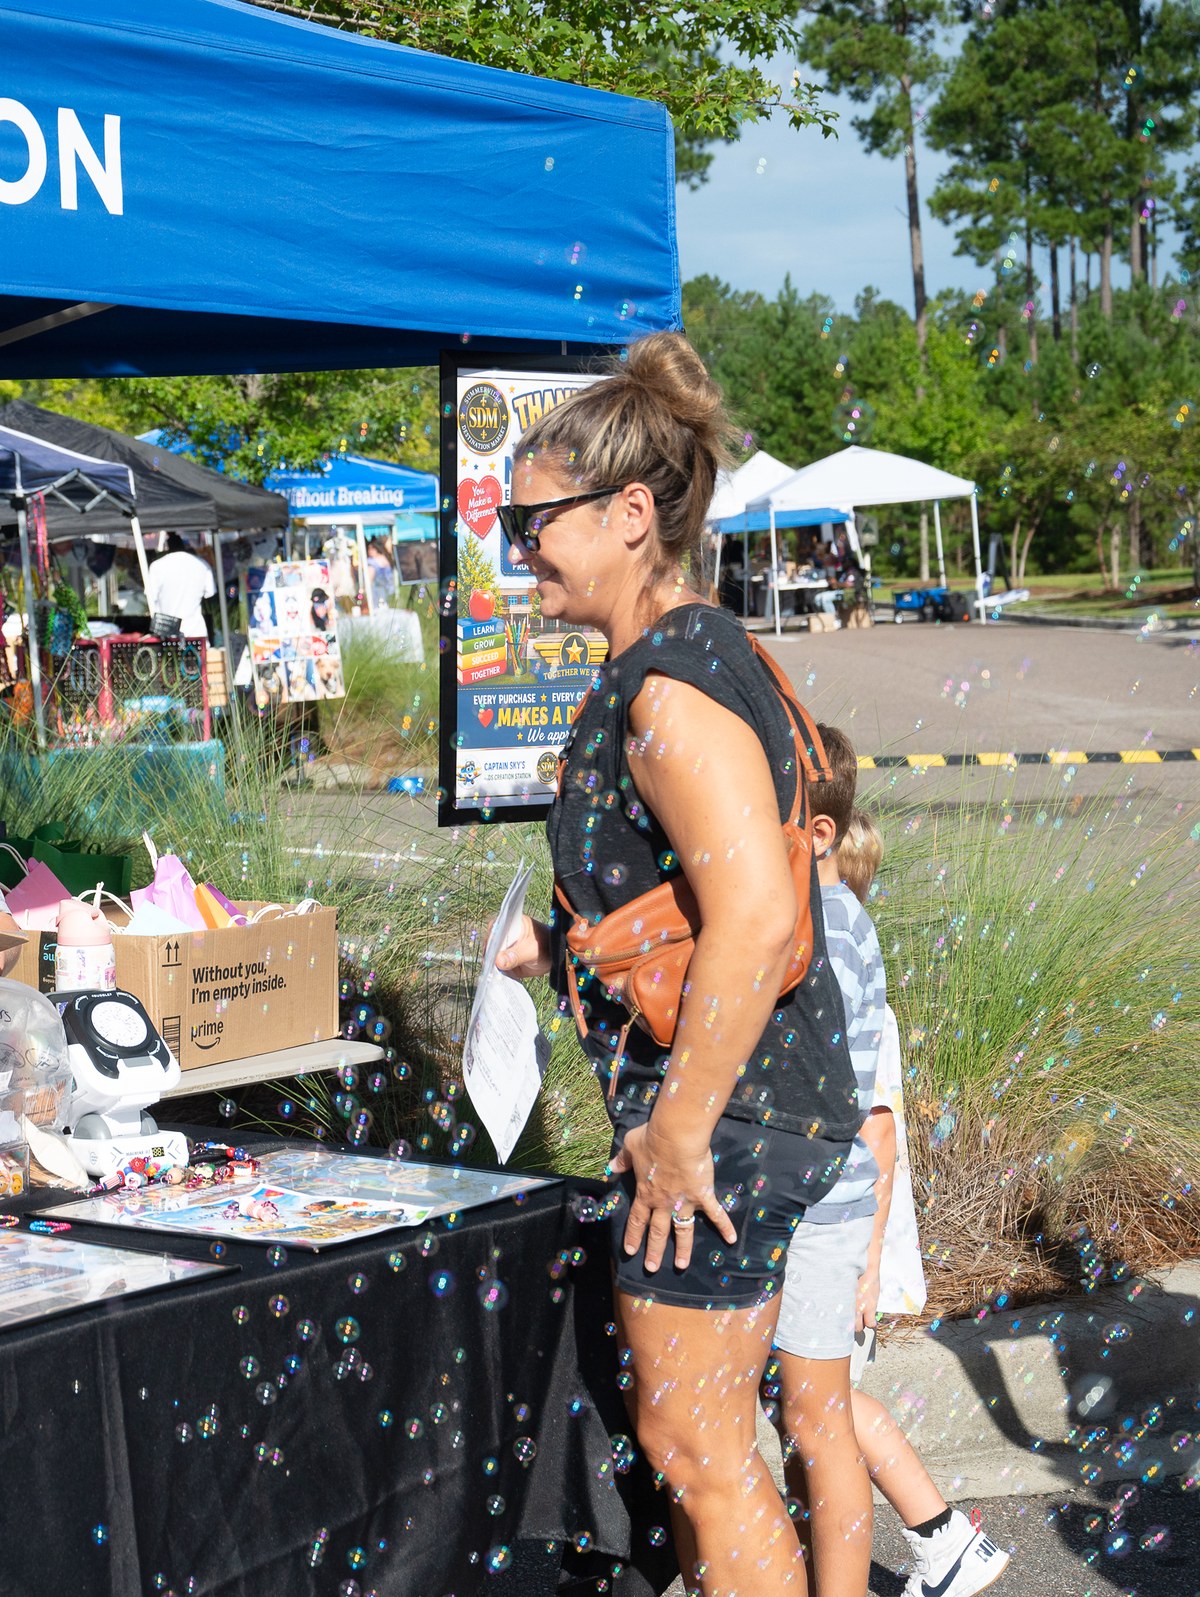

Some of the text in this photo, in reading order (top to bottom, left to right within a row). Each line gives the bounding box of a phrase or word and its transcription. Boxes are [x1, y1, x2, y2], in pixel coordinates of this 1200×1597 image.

[513, 388, 579, 430] THA
[468, 406, 498, 429] SDM
[461, 425, 506, 450] DESTINATION MARKET
[337, 485, 404, 507] Breaking
[472, 486, 485, 496] You
[468, 496, 492, 509] Make a
[466, 503, 498, 523] Difference!
[473, 624, 495, 636] LEARN
[474, 639, 495, 650] GROW
[472, 652, 499, 665] SUCCEED
[471, 666, 500, 681] TOGETHER
[543, 668, 591, 680] TOGETHER WE
[473, 692, 575, 705] EVERY PURCHASE EVERY
[497, 706, 562, 727] MAKES A
[528, 728, 545, 742] We
[484, 762, 508, 771] CAPTAIN
[193, 961, 267, 984] Without you,
[192, 974, 286, 1004] I'm empty inside.
[191, 1020, 223, 1041] prime
